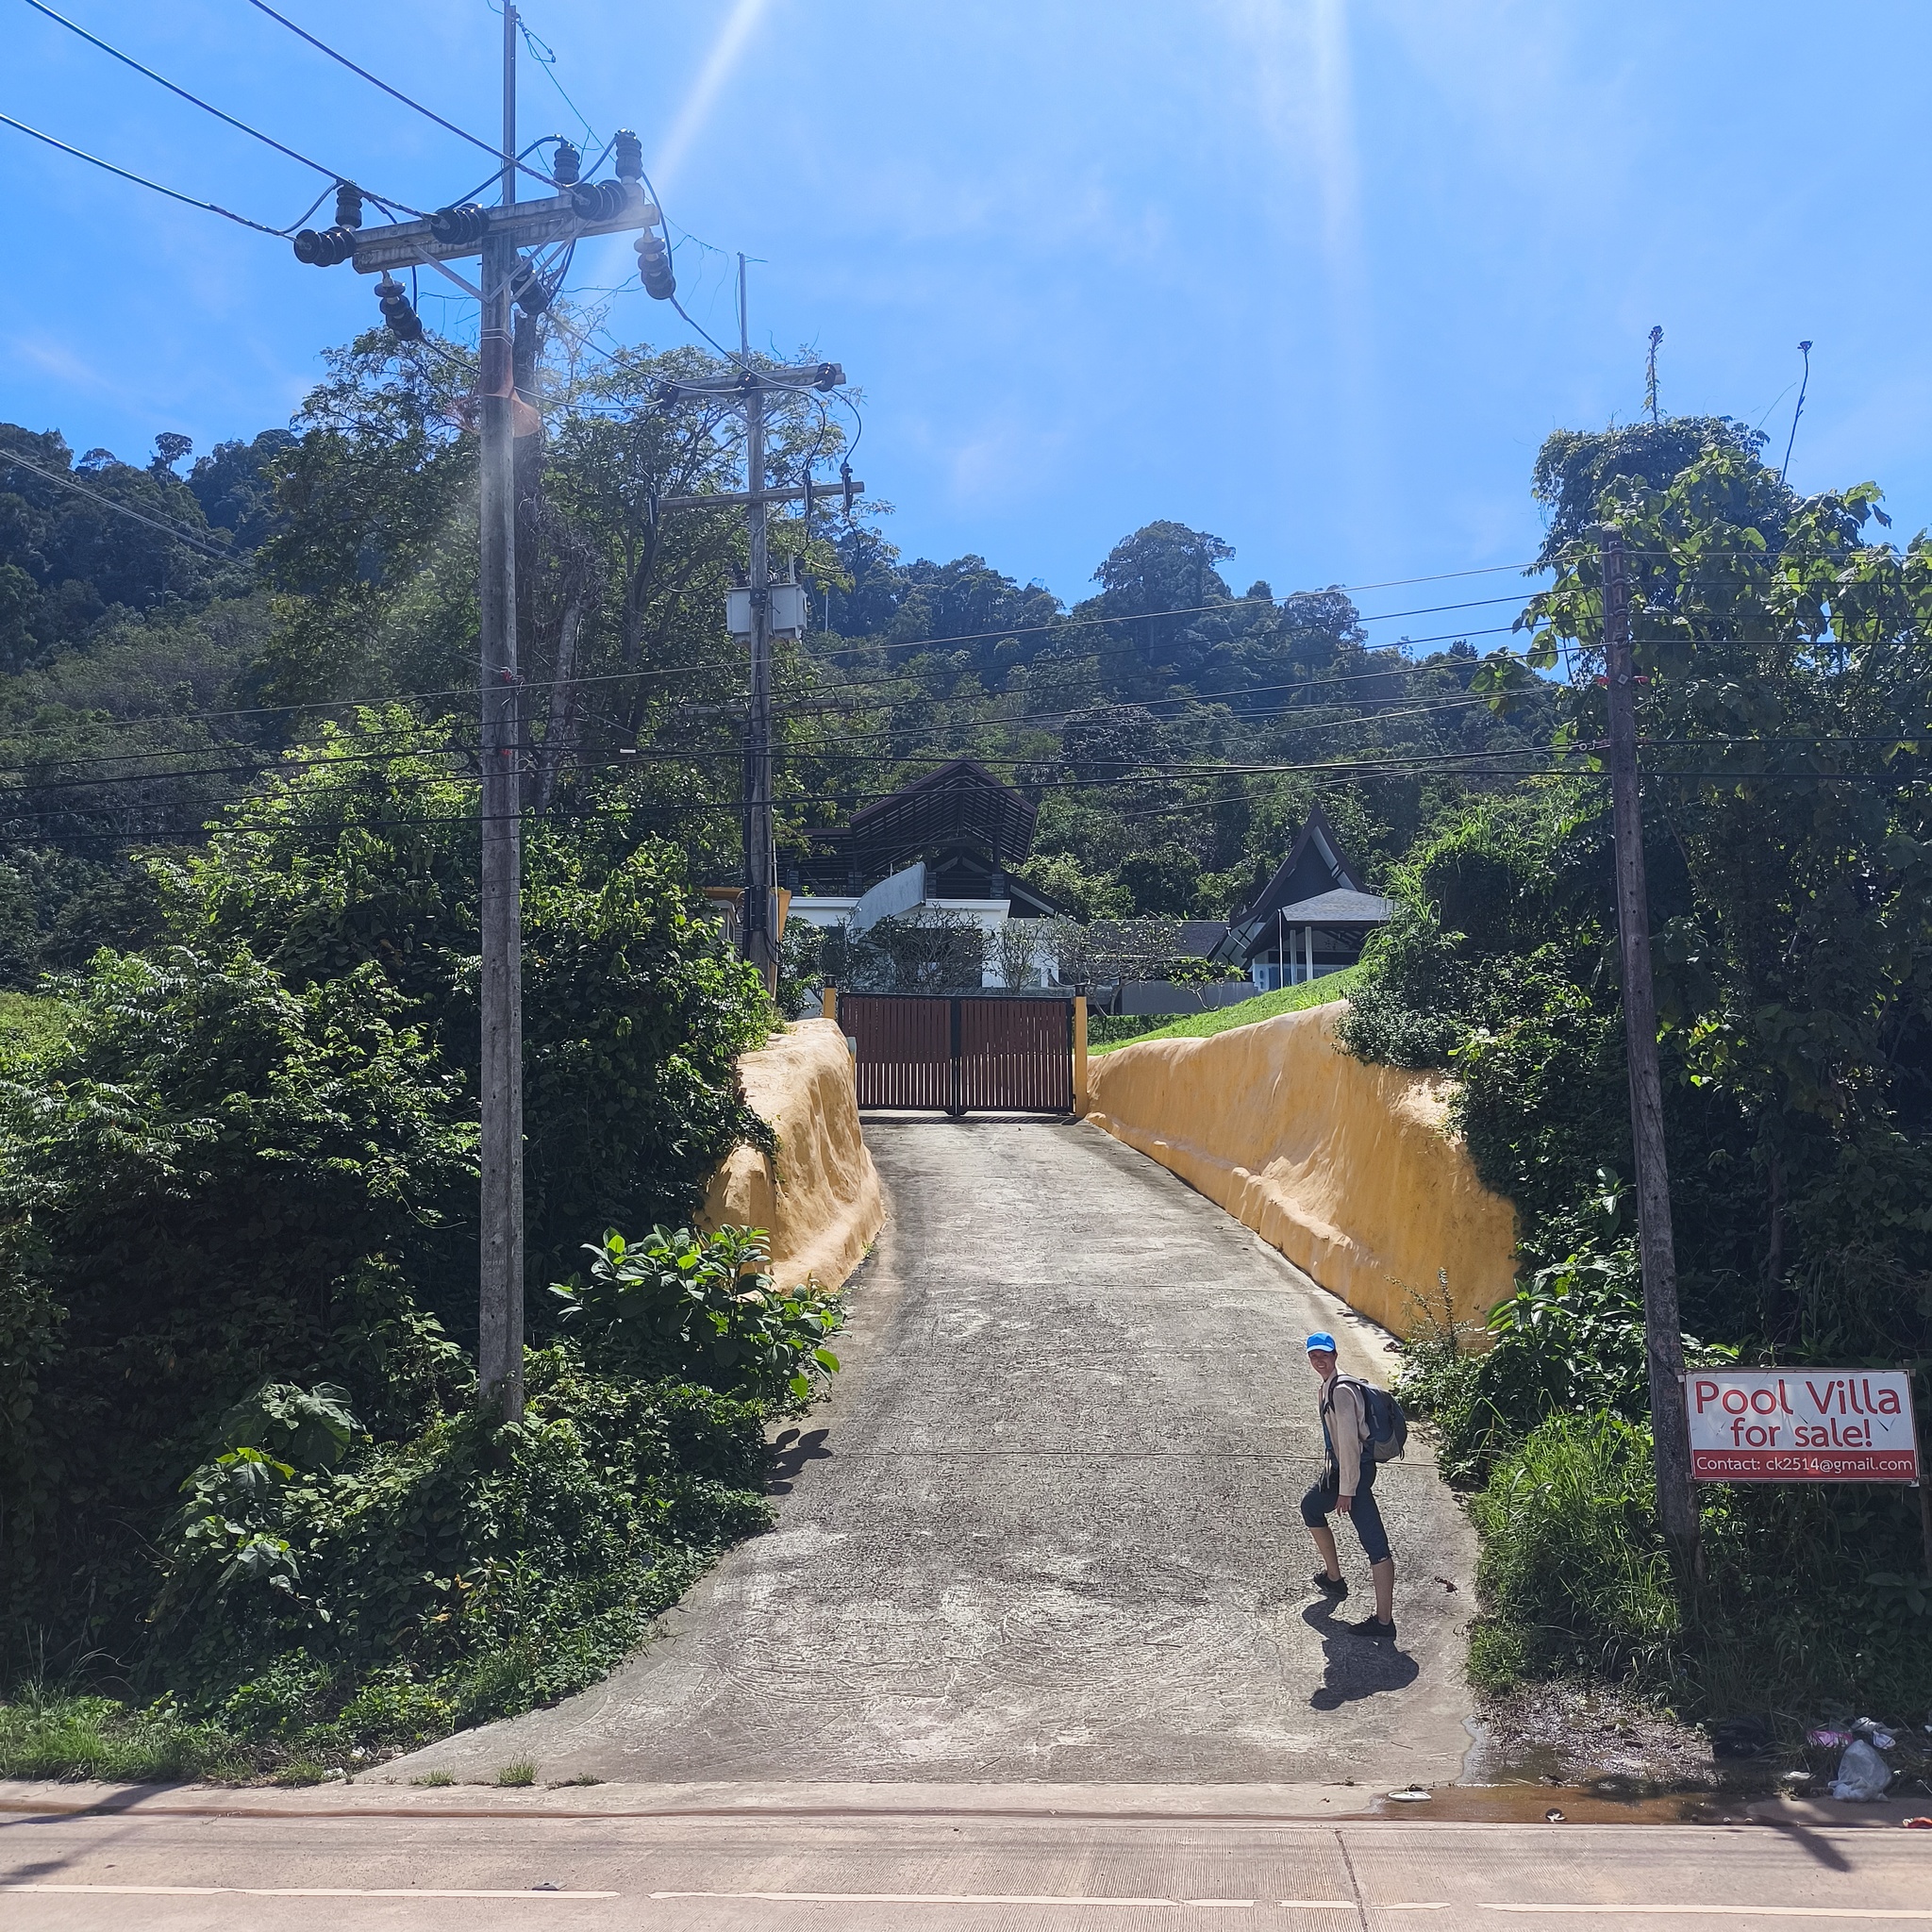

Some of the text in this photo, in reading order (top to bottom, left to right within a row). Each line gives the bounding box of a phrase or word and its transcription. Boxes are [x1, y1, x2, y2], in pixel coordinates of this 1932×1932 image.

[1695, 1379, 1901, 1414] Pool Villa
[1731, 1417, 1873, 1447] for sale!
[1696, 1457, 1913, 1474] Contact: ck2514@gmail.com
